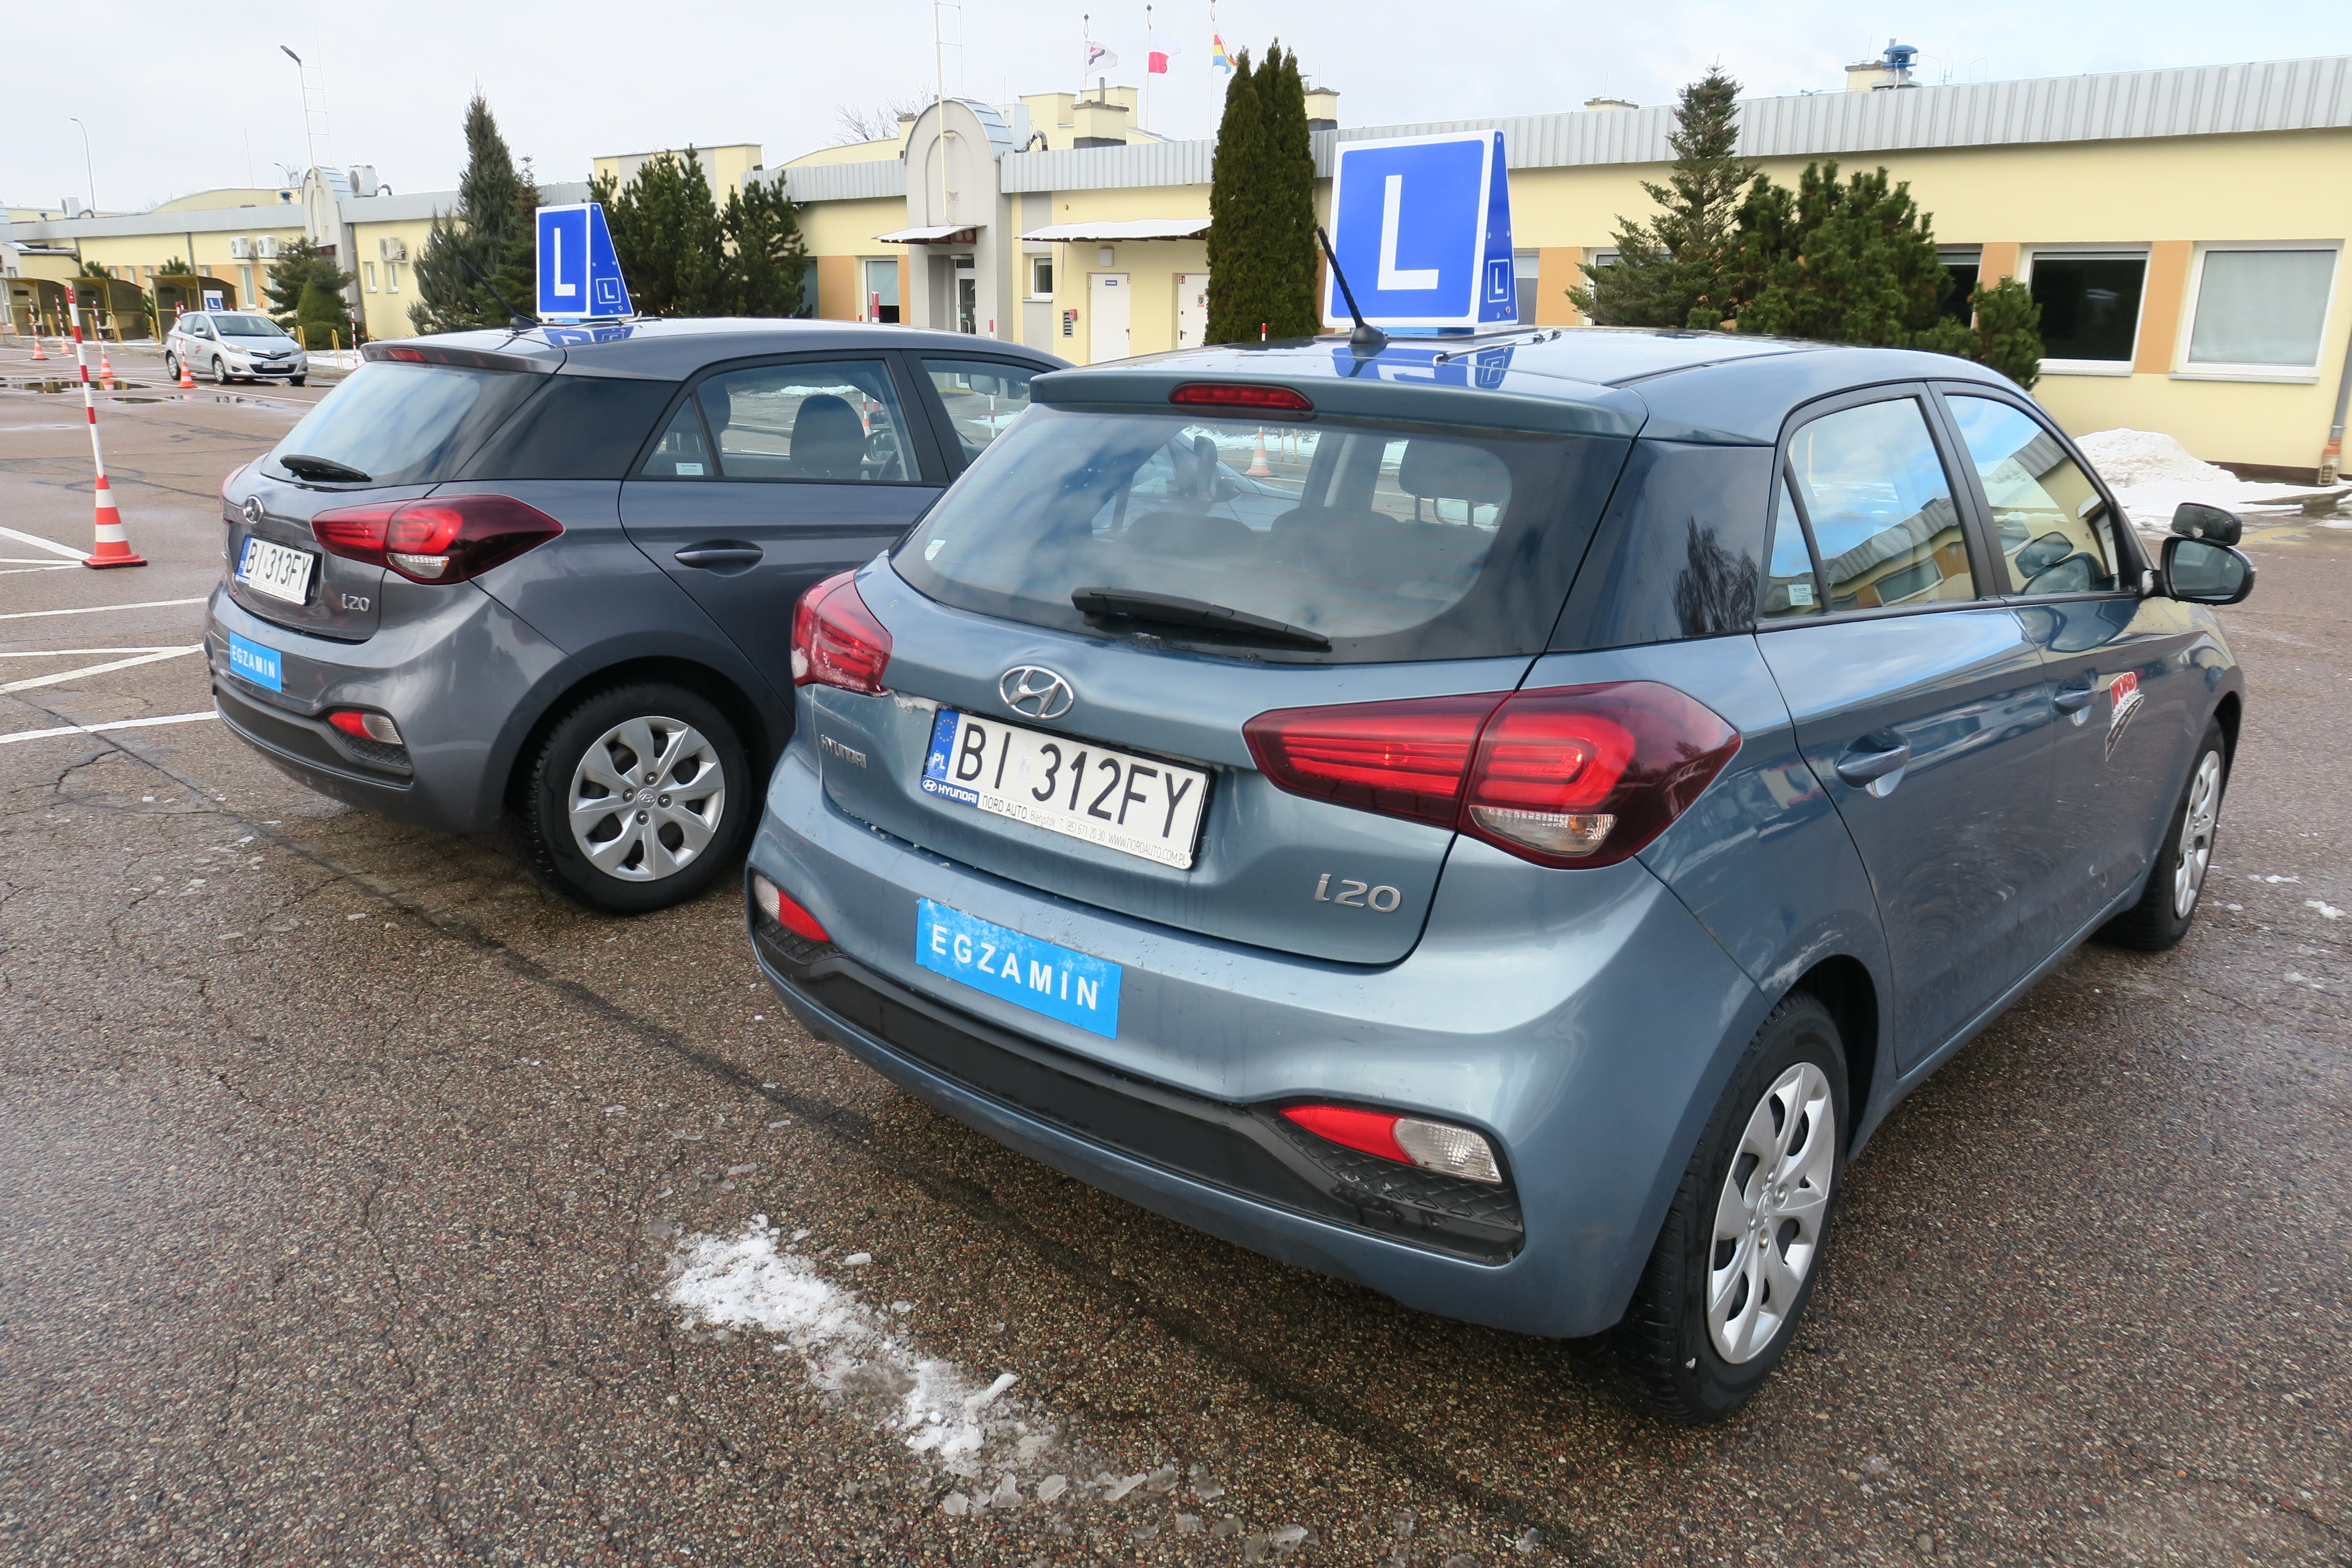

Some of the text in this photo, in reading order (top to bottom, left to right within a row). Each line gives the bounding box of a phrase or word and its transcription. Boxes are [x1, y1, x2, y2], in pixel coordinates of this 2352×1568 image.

[1377, 174, 1439, 291] L
[554, 228, 575, 296] L
[604, 283, 615, 299] L
[1494, 268, 1504, 294] L
[210, 298, 218, 308] L
[246, 542, 310, 590] BI 313FY
[341, 593, 370, 612] i20
[232, 645, 275, 678] EGZAMIN
[820, 734, 867, 769] HYUNDAI
[931, 752, 946, 769] PL
[955, 722, 1193, 838] BI 312FY
[938, 783, 977, 804] HYUNDAI
[982, 795, 1004, 812] NORD
[1006, 803, 1027, 819] AUTO
[1030, 810, 1057, 828] Białystok
[1065, 819, 1076, 832] (85)
[1077, 824, 1088, 837] 671
[1089, 827, 1097, 839] 20
[1098, 829, 1105, 842] 30
[1314, 873, 1401, 913] i20
[931, 923, 1098, 1010] EGZAMIN
